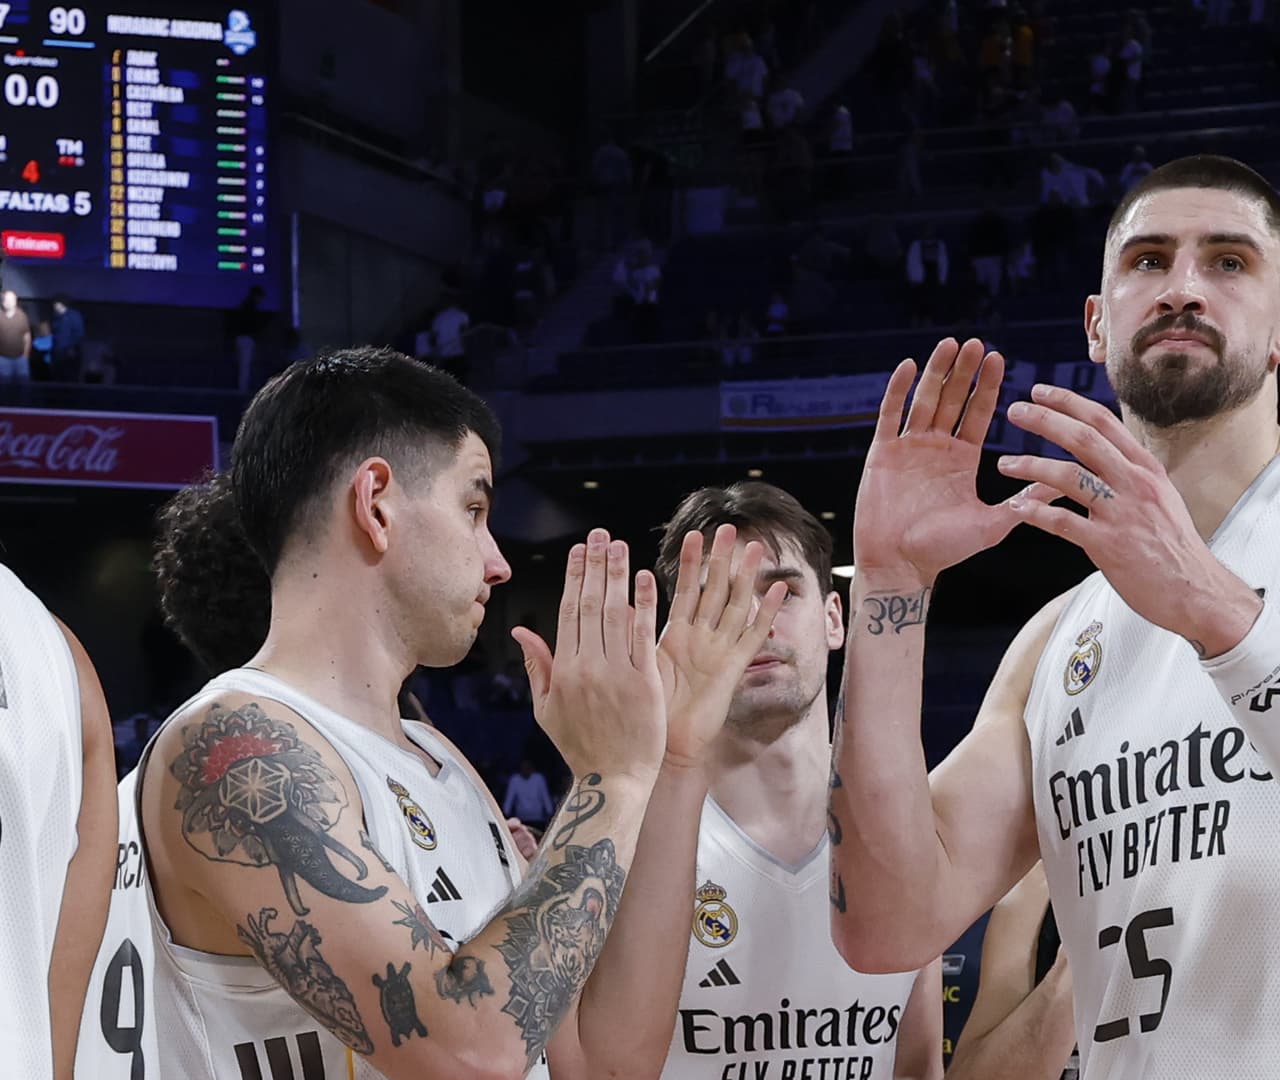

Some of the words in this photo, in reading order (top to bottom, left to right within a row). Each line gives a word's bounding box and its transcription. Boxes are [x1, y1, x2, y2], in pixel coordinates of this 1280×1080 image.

[49, 7, 86, 35] 90
[4, 73, 59, 107] 0.0
[56, 139, 83, 155] TM
[22, 159, 40, 184] 4
[73, 191, 91, 215] 5
[1077, 829, 1114, 898] FLY
[679, 997, 901, 1055] Emirates
